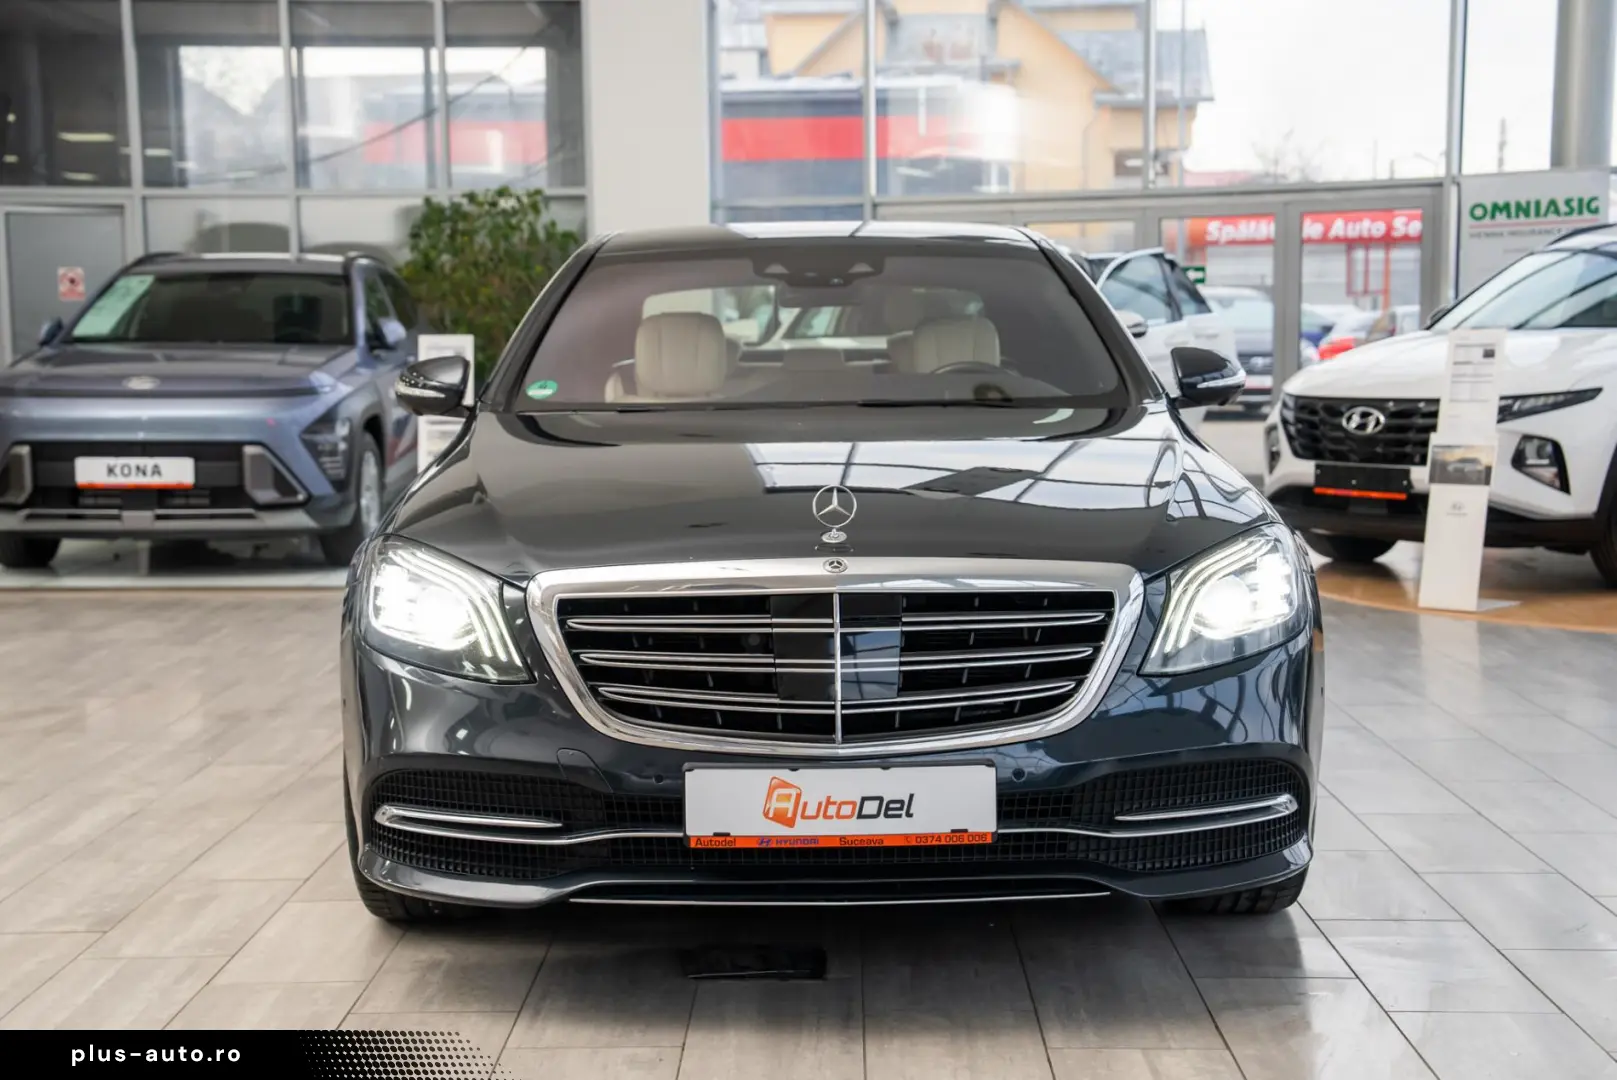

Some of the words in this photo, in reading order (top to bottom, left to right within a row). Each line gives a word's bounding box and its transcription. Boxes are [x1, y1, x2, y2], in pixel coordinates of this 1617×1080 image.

[1469, 196, 1600, 221] OMNIASIG
[1328, 217, 1387, 240] Auto
[106, 463, 163, 478] KONA
[766, 784, 915, 822] AutoDel
[694, 837, 737, 847] Autodel
[839, 837, 884, 846] Suceava
[915, 835, 942, 844] 0374
[945, 834, 964, 843] 006
[967, 833, 987, 842] 006
